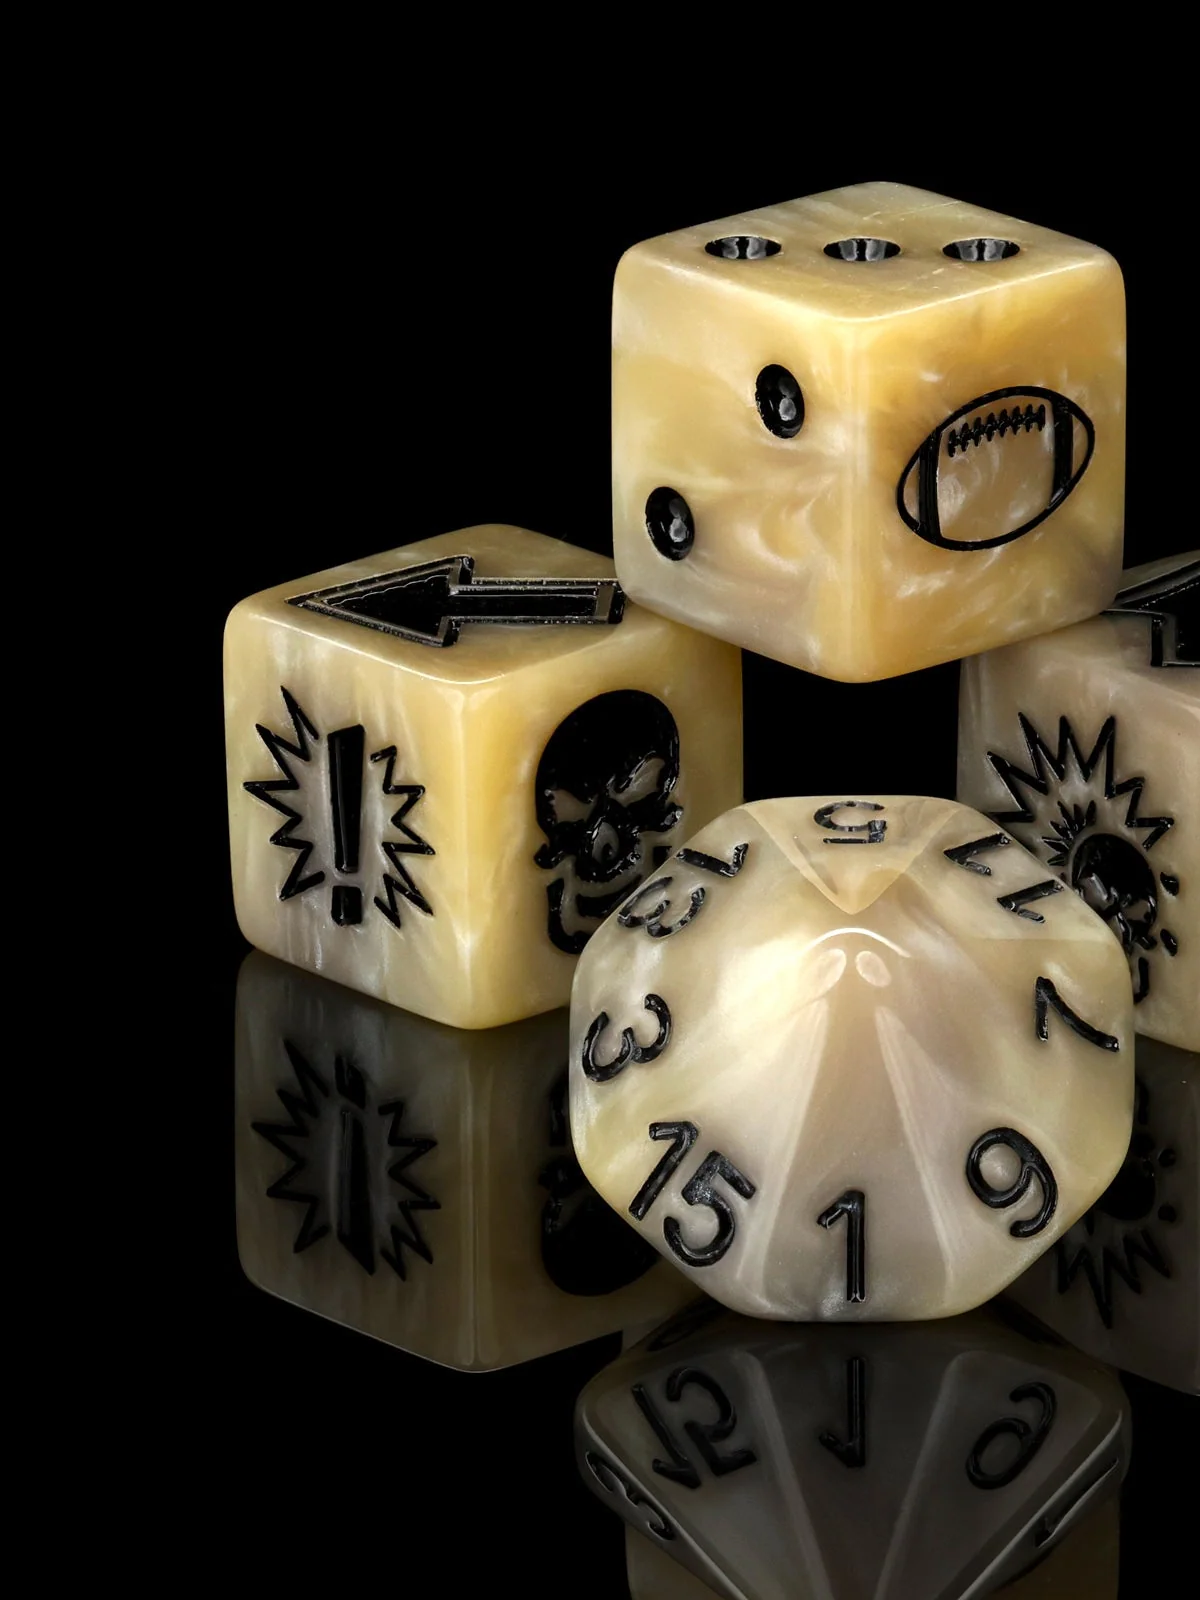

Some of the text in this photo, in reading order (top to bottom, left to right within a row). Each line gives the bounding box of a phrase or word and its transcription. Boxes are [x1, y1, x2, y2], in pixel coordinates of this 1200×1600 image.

[814, 801, 888, 844] 5
[943, 832, 1065, 923] 11
[581, 993, 672, 1082] 3
[628, 1120, 756, 1267] 15
[965, 1126, 1059, 1238] 9
[817, 1189, 866, 1302] 1
